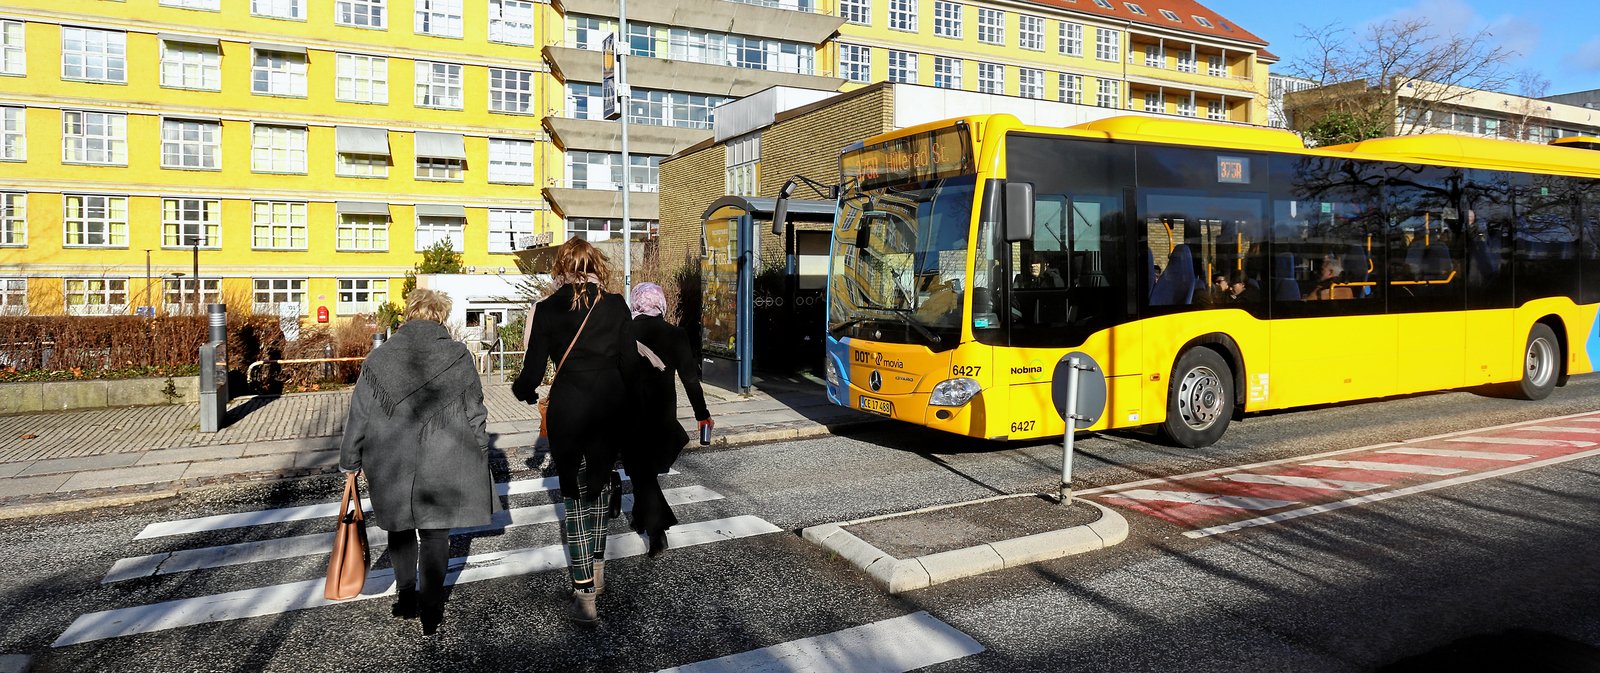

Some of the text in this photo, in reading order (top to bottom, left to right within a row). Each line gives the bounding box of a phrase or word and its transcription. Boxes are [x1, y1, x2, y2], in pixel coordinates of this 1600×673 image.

[885, 144, 928, 173] Hillerød
[932, 142, 950, 164] St.
[854, 350, 870, 364] DOT
[883, 358, 904, 369] movia
[952, 364, 982, 377] 6427
[1010, 366, 1043, 375] Nobina
[872, 400, 879, 410] 17
[1011, 420, 1036, 433] 6427
